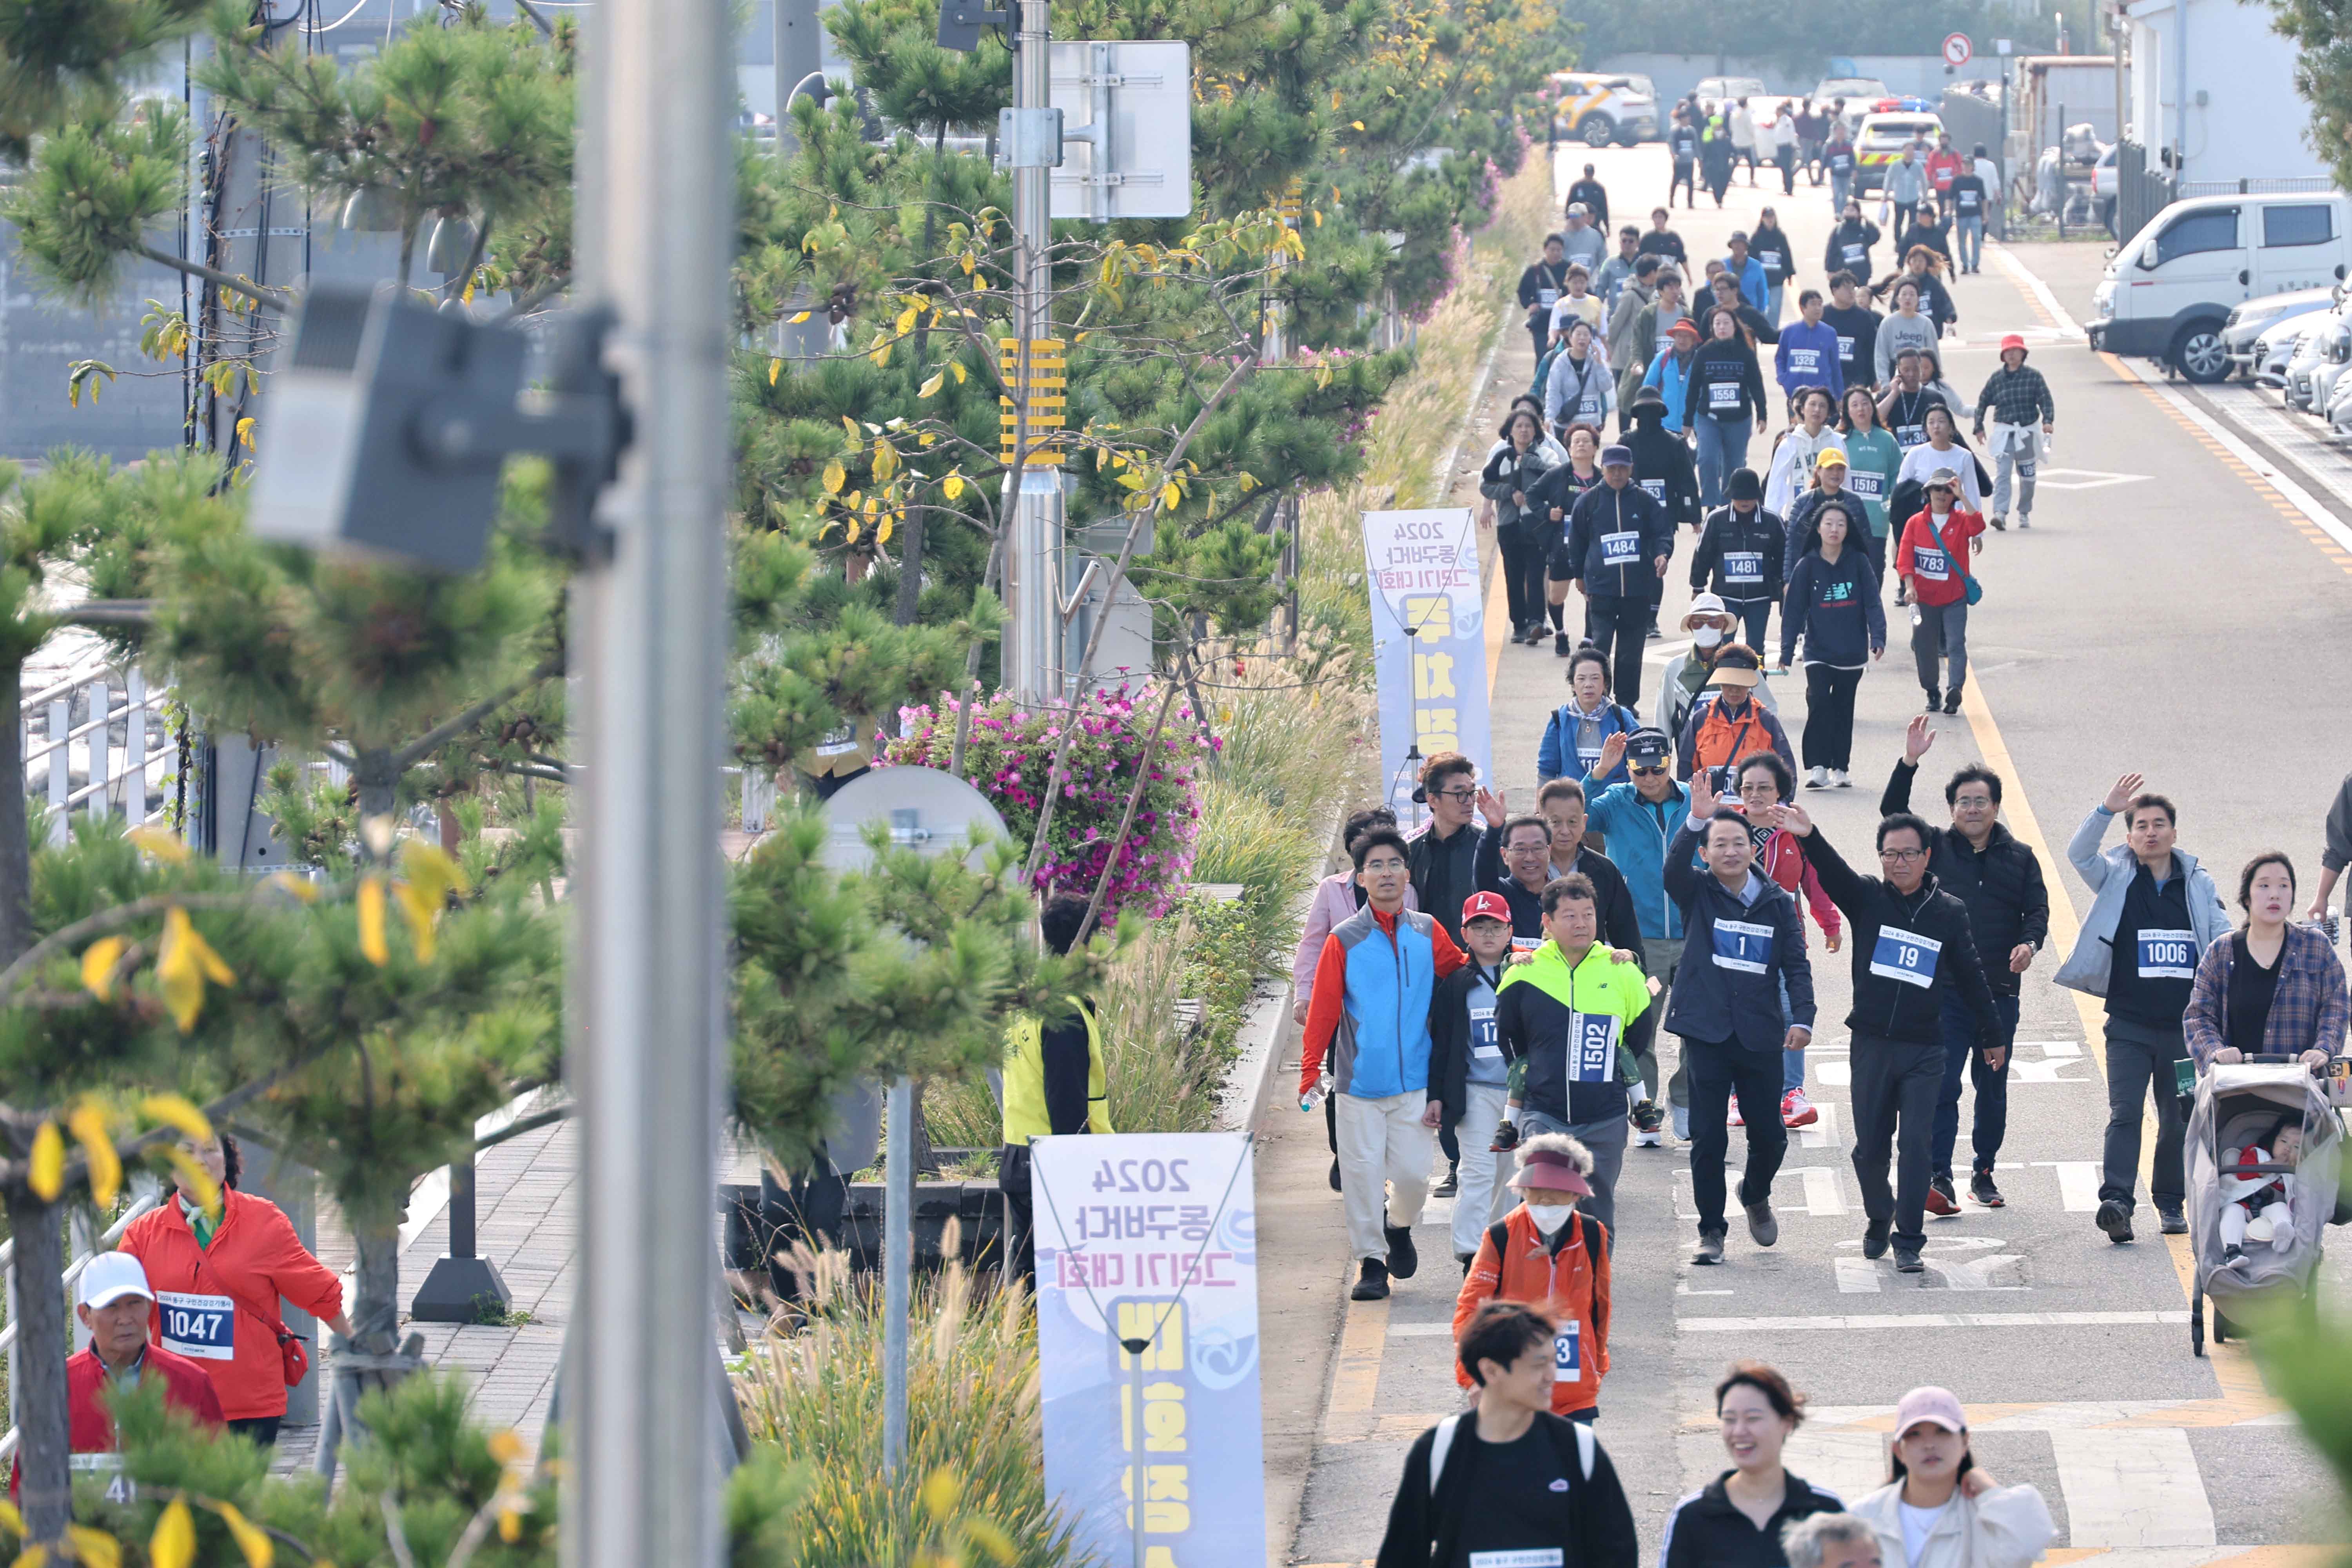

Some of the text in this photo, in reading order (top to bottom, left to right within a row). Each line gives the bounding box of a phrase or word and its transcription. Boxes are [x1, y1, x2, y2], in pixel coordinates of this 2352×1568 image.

[1895, 330, 1922, 342] Jeep
[1838, 343, 1850, 353] 57
[1795, 355, 1815, 365] 1328
[1713, 389, 1735, 400] 1558
[1579, 401, 1595, 412] 495
[1854, 478, 1878, 492] 1518
[1648, 487, 1661, 498] 53
[1606, 540, 1636, 555] 1484
[1731, 560, 1757, 573] 1481
[1919, 555, 1944, 571] 1783
[1739, 936, 1746, 955] 1
[2147, 942, 2187, 963] 1006
[1898, 945, 1919, 967] 19
[1482, 1022, 1497, 1042] 17
[1584, 1024, 1607, 1071] 1502
[168, 1309, 223, 1340] 1047
